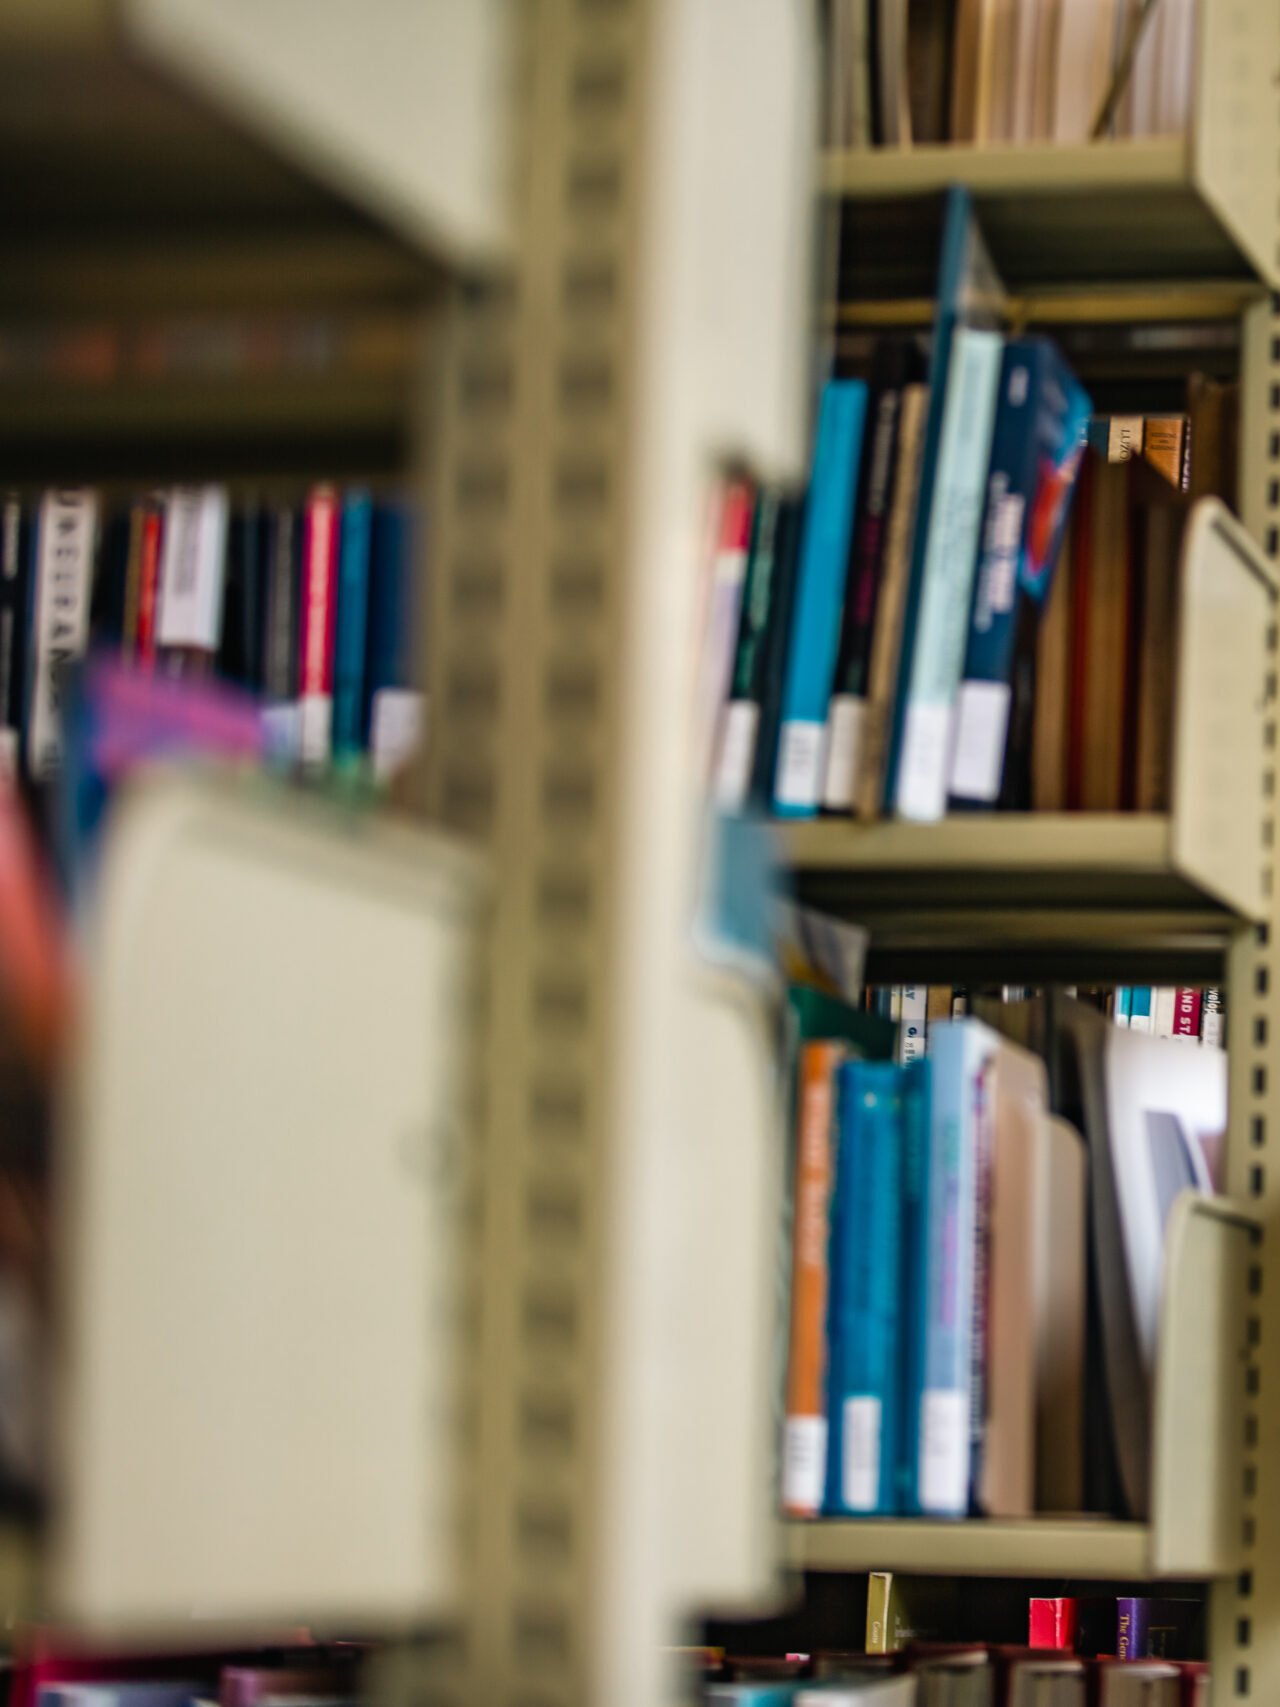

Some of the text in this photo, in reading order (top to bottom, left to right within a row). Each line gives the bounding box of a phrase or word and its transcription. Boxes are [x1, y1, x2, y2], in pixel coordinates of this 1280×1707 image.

[1119, 429, 1132, 462] LUZO
[1181, 987, 1194, 1013] AND
[1120, 1613, 1130, 1634] The
